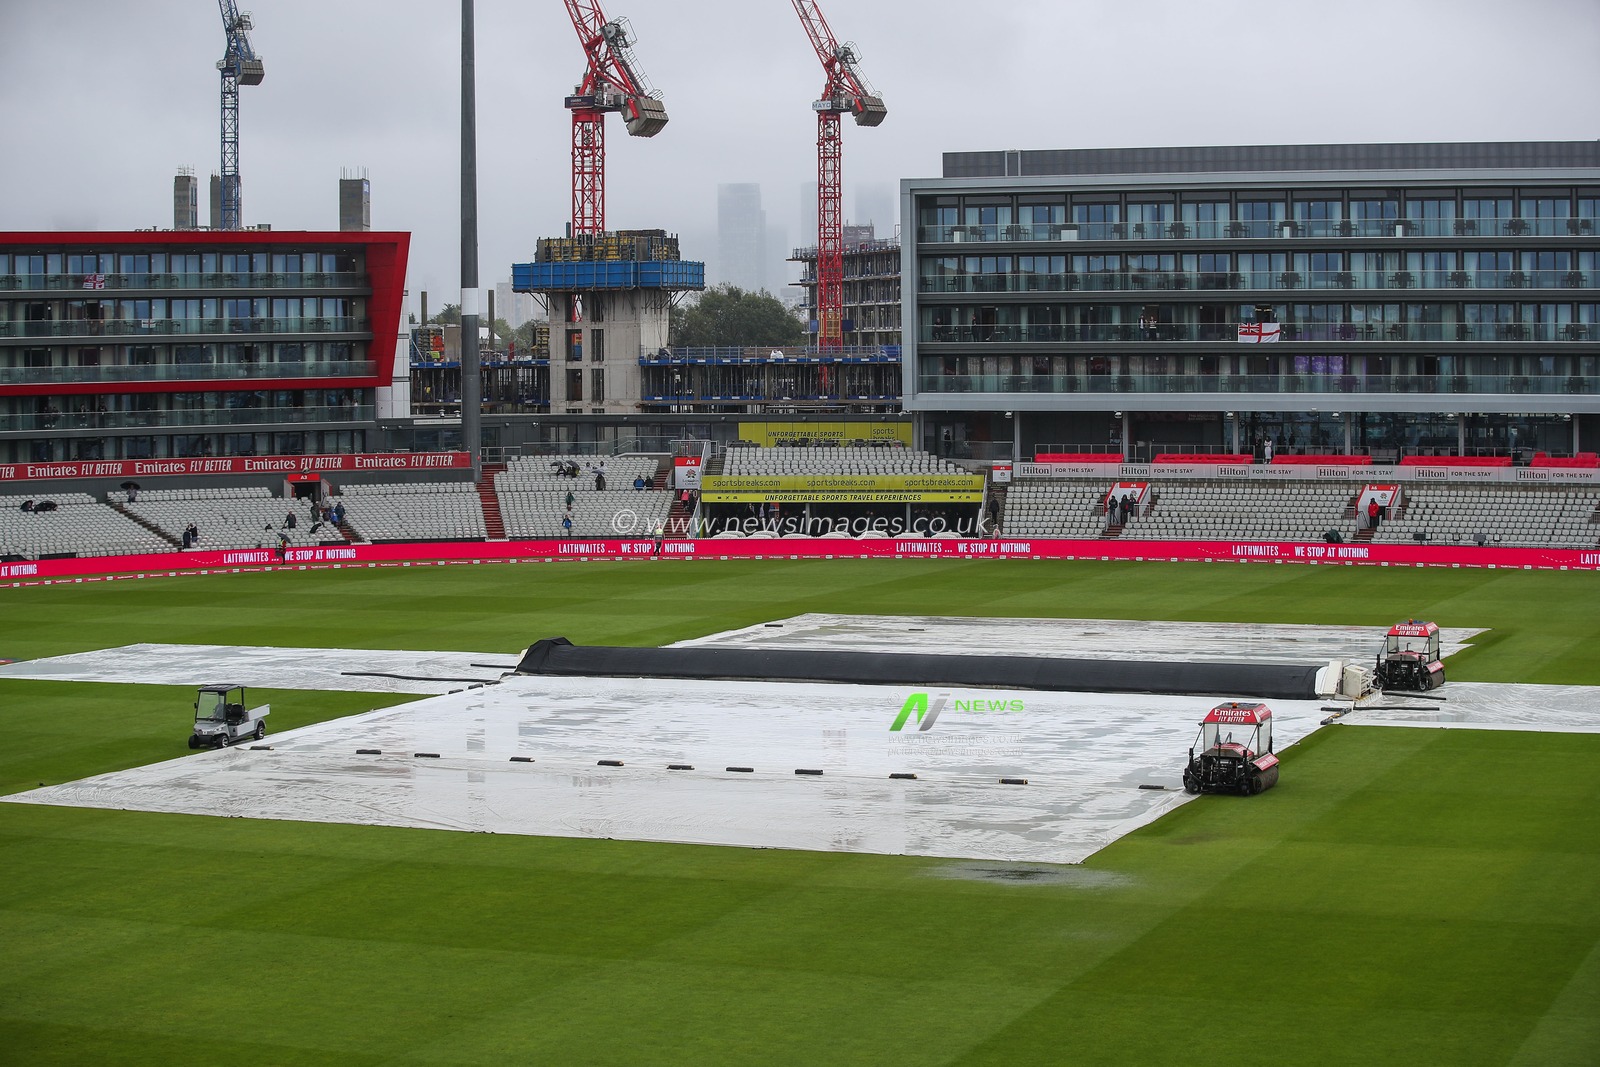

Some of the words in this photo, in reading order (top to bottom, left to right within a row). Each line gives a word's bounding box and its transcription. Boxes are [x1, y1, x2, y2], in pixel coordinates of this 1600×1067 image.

[135, 462, 186, 474] Emirates
[190, 461, 204, 472] FLY
[204, 460, 232, 471] BETTER
[245, 459, 296, 471] Emirates
[300, 458, 313, 469] FLY
[314, 458, 342, 469] BETTER
[355, 456, 406, 468] Emirates
[410, 456, 425, 466] FLY
[426, 455, 453, 466] BETTER
[27, 464, 77, 478] Emirates
[81, 464, 94, 476] FLY
[96, 462, 122, 474] BETTER
[1022, 466, 1050, 474] Hilton
[1121, 466, 1148, 475] Hilton
[1220, 467, 1247, 476] Hilton
[1319, 468, 1347, 476] Hilton
[1418, 469, 1445, 478] Hilton
[1519, 470, 1546, 479] Hilton
[559, 544, 605, 553] LAITHWAITES
[621, 544, 631, 553] WE
[634, 544, 652, 553] STOP
[665, 543, 694, 553] NOTHING
[896, 542, 942, 552] LAITHWAITES
[958, 543, 968, 552] WE
[970, 543, 988, 553] STOP
[990, 543, 998, 553] AT
[1001, 543, 1030, 553] NOTHING
[1232, 545, 1278, 556] LAITHWAITES
[1295, 546, 1305, 557] WE
[1308, 547, 1325, 557] STOP
[1328, 547, 1336, 557] AT
[1338, 548, 1368, 558] NOTHING
[224, 552, 268, 563] LAITHWAITES
[296, 550, 313, 560] STOP
[316, 550, 323, 559] AT
[326, 549, 356, 559] NOTHING
[1, 566, 8, 576] AT
[10, 564, 37, 576] NOTHING
